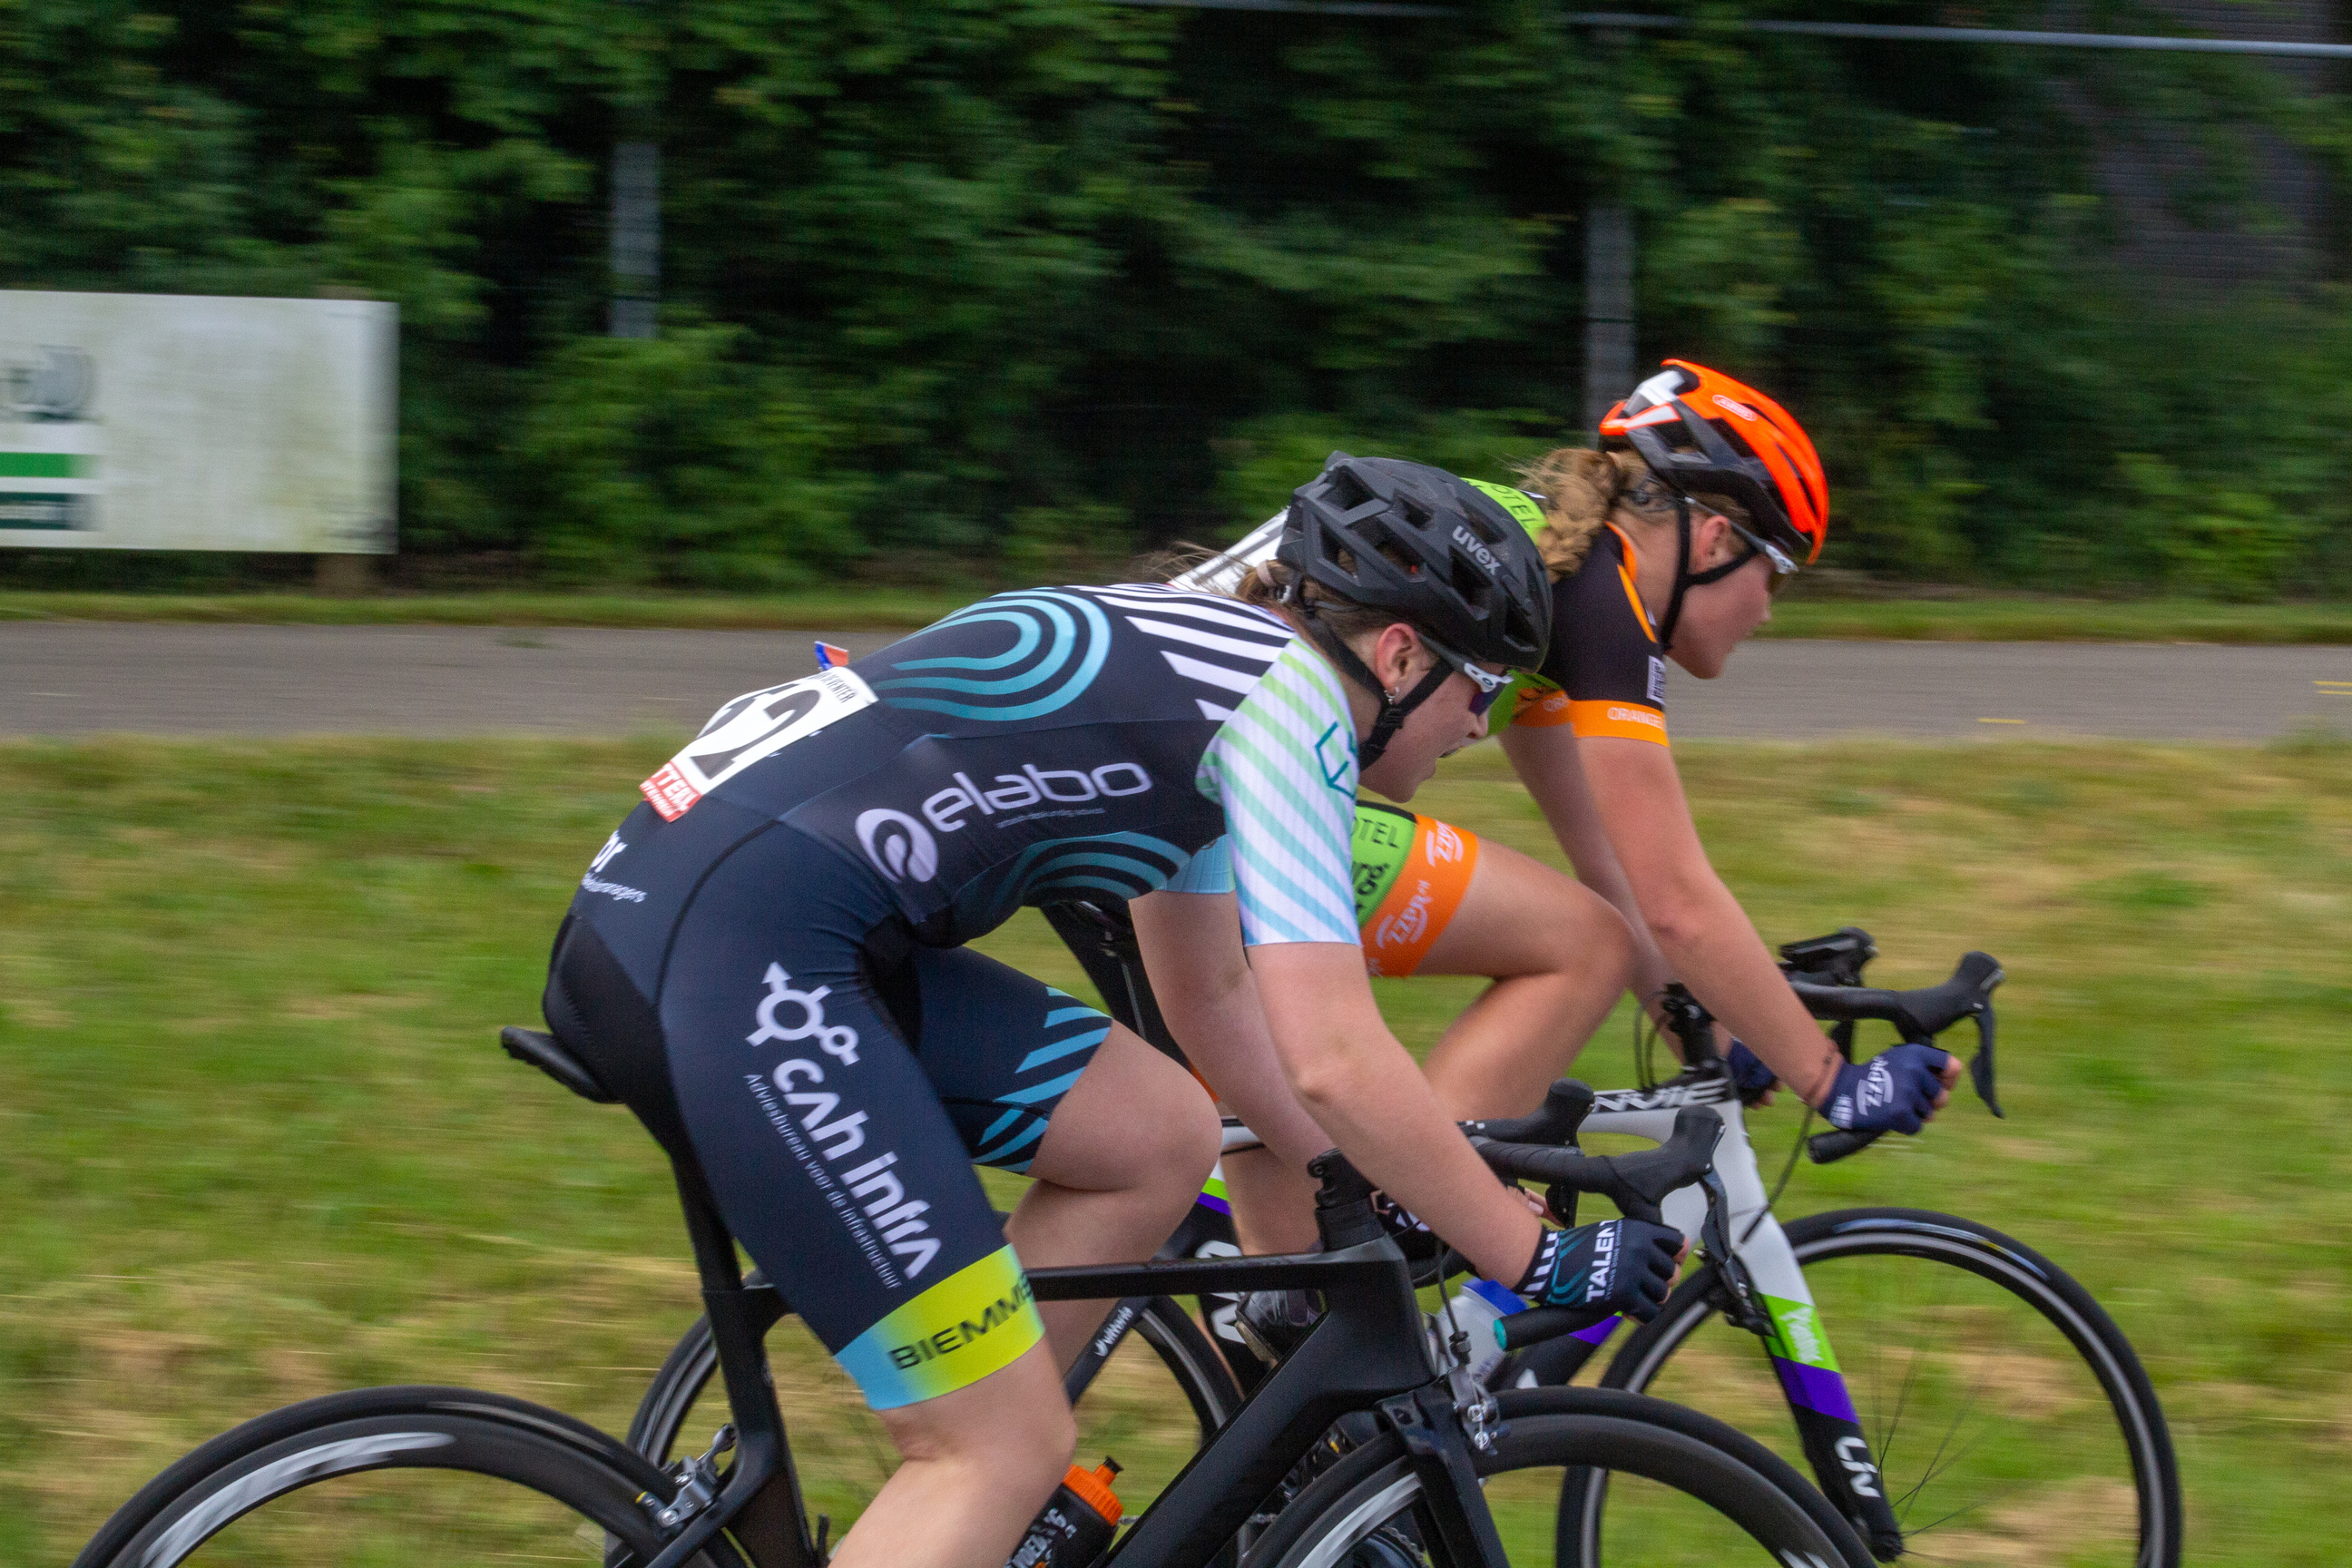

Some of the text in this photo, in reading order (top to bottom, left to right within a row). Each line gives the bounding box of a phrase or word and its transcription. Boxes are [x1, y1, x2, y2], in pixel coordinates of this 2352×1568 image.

[1453, 525, 1502, 575] uvex
[922, 762, 1152, 832] elabo
[743, 1074, 902, 1289] Adviesbureau voor de infrastructuur
